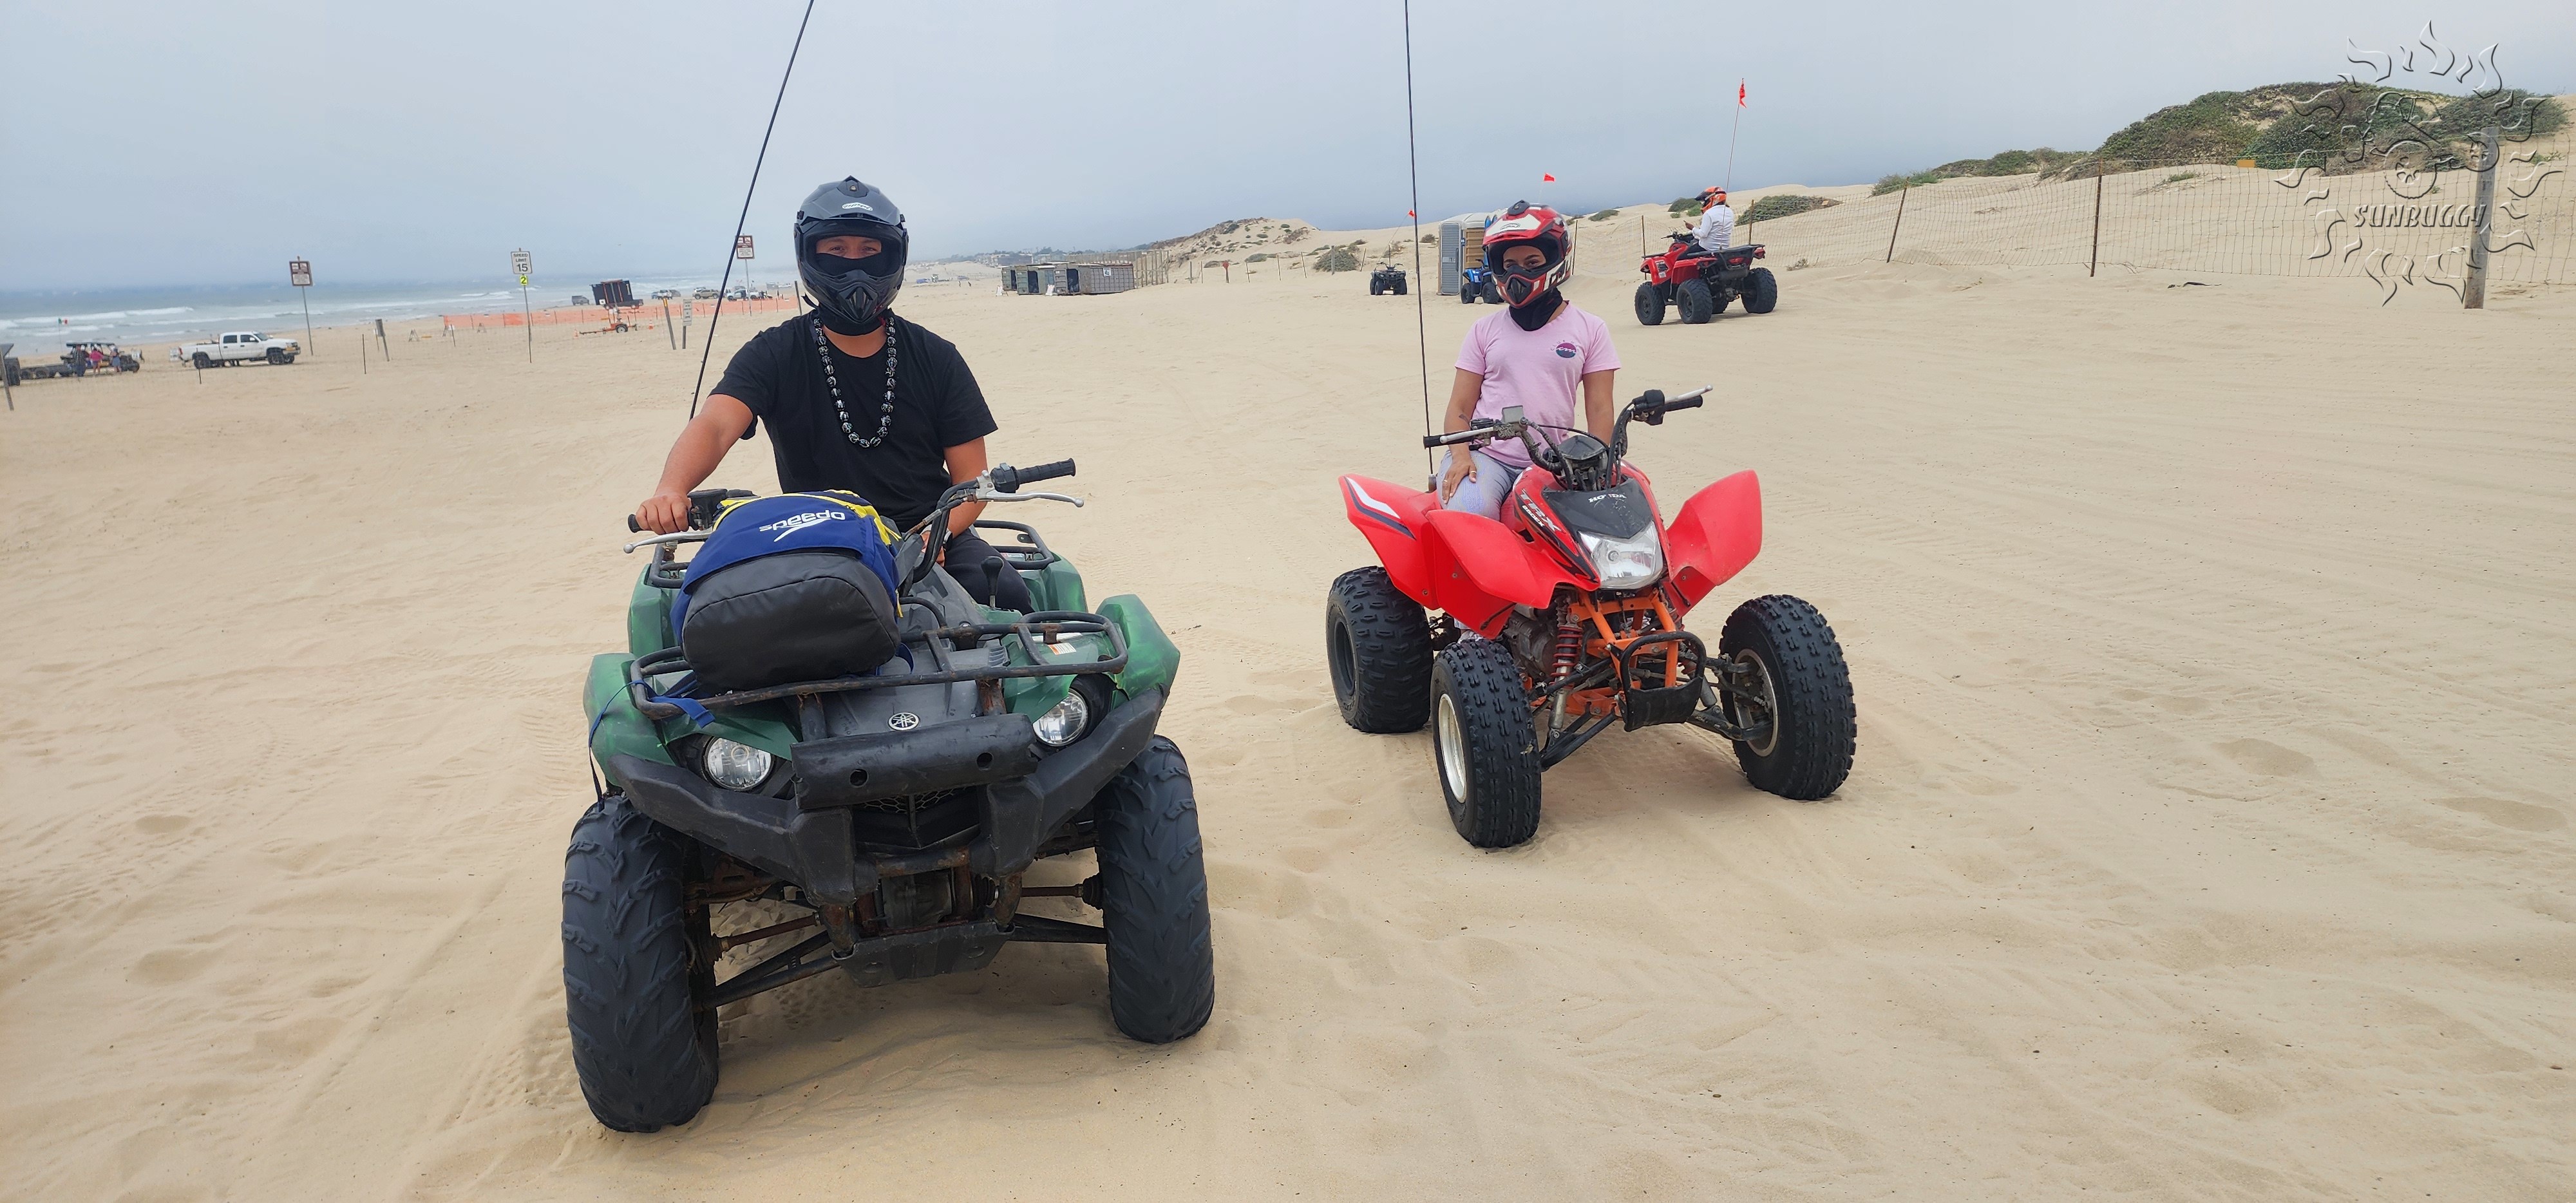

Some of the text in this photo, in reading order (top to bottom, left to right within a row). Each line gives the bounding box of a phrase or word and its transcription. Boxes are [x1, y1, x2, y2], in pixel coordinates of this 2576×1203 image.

[516, 263, 528, 272] 15
[759, 509, 846, 532] speedo
[1520, 488, 1562, 531] TRX
